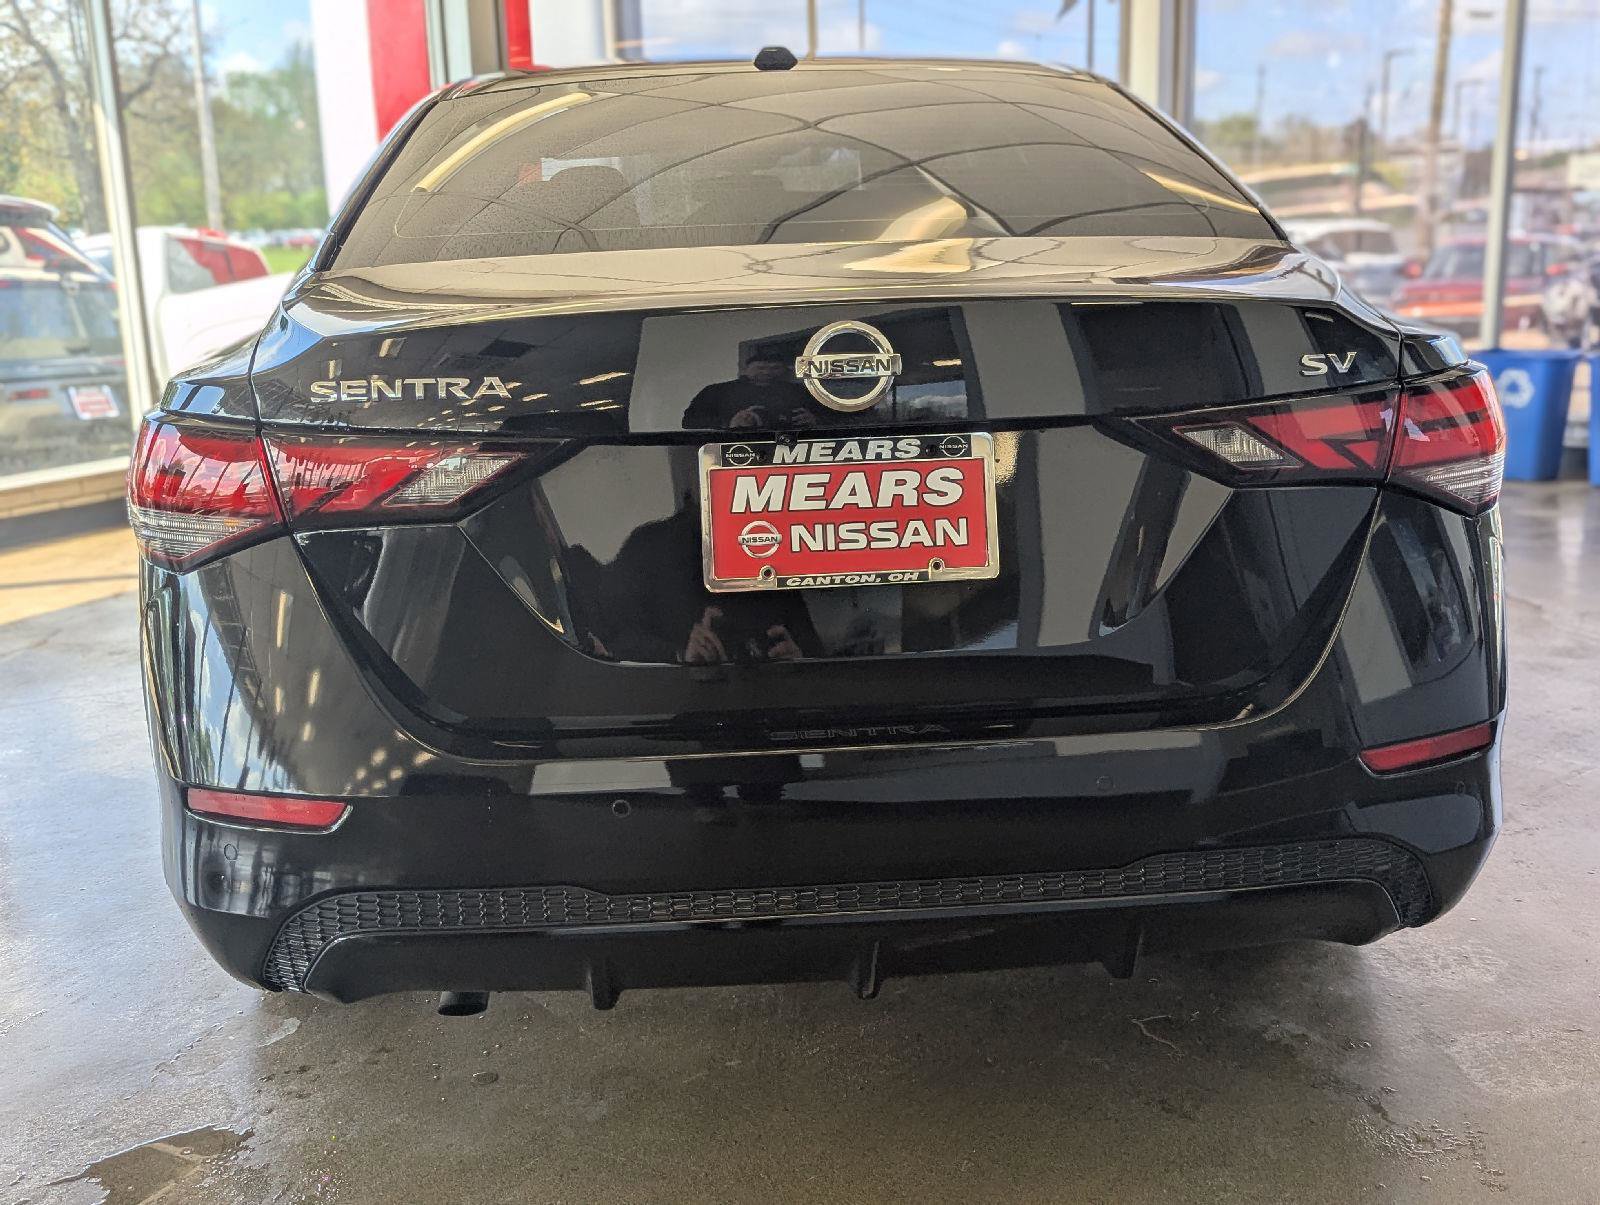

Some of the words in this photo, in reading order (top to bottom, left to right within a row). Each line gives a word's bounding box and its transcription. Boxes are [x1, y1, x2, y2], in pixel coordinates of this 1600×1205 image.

[807, 358, 891, 374] NISSAN
[1302, 352, 1357, 376] SV
[310, 377, 512, 402] SENTRA
[772, 438, 921, 464] MEARS
[731, 468, 963, 513] MEARS
[741, 535, 778, 543] NISSAN
[791, 518, 968, 551] NISSAN
[786, 577, 882, 588] CANTON,
[888, 572, 919, 582] OH
